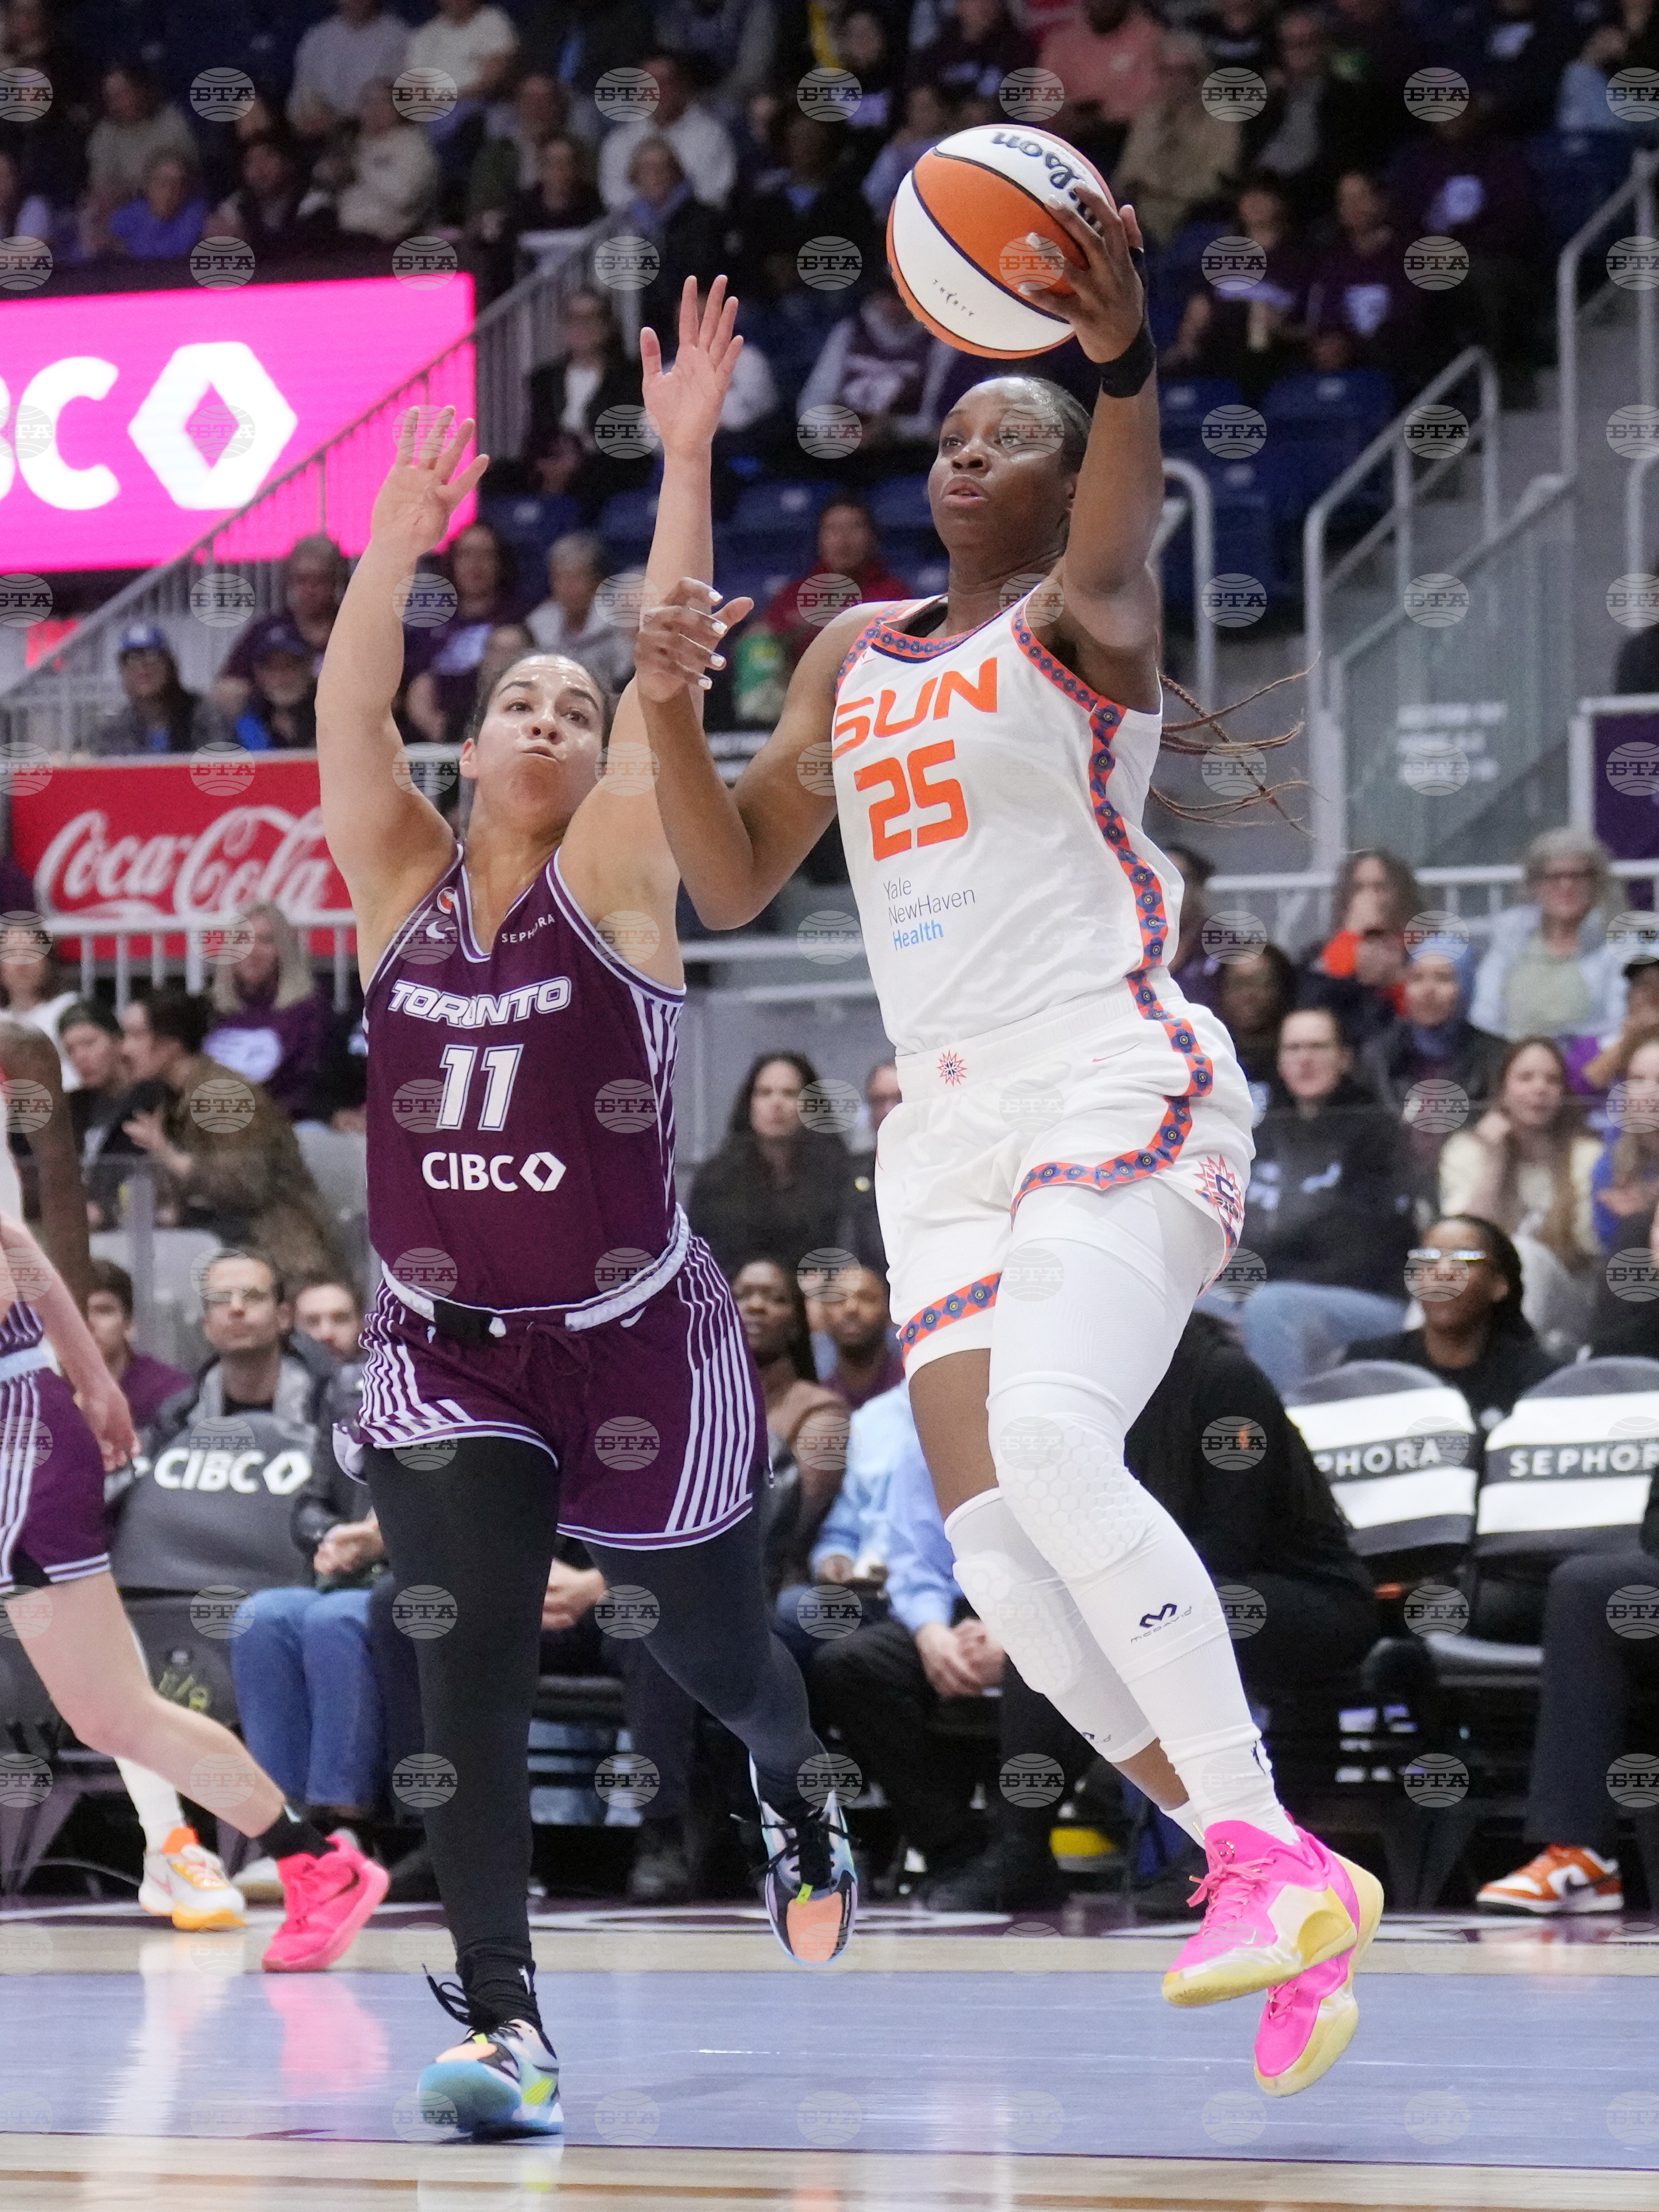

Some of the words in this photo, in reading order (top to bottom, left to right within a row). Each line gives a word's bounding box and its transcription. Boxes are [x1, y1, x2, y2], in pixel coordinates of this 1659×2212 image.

[832, 657, 997, 761] SUN
[854, 740, 968, 862] 25
[35, 805, 330, 917] Coca-Cola
[883, 878, 912, 901] Yale
[888, 889, 975, 925] NewHaven
[501, 914, 555, 943] SEPHRA
[892, 919, 944, 951] Health
[435, 1044, 524, 1131] 11
[422, 1152, 518, 1192] CIBC
[154, 1447, 264, 1494] CIBC
